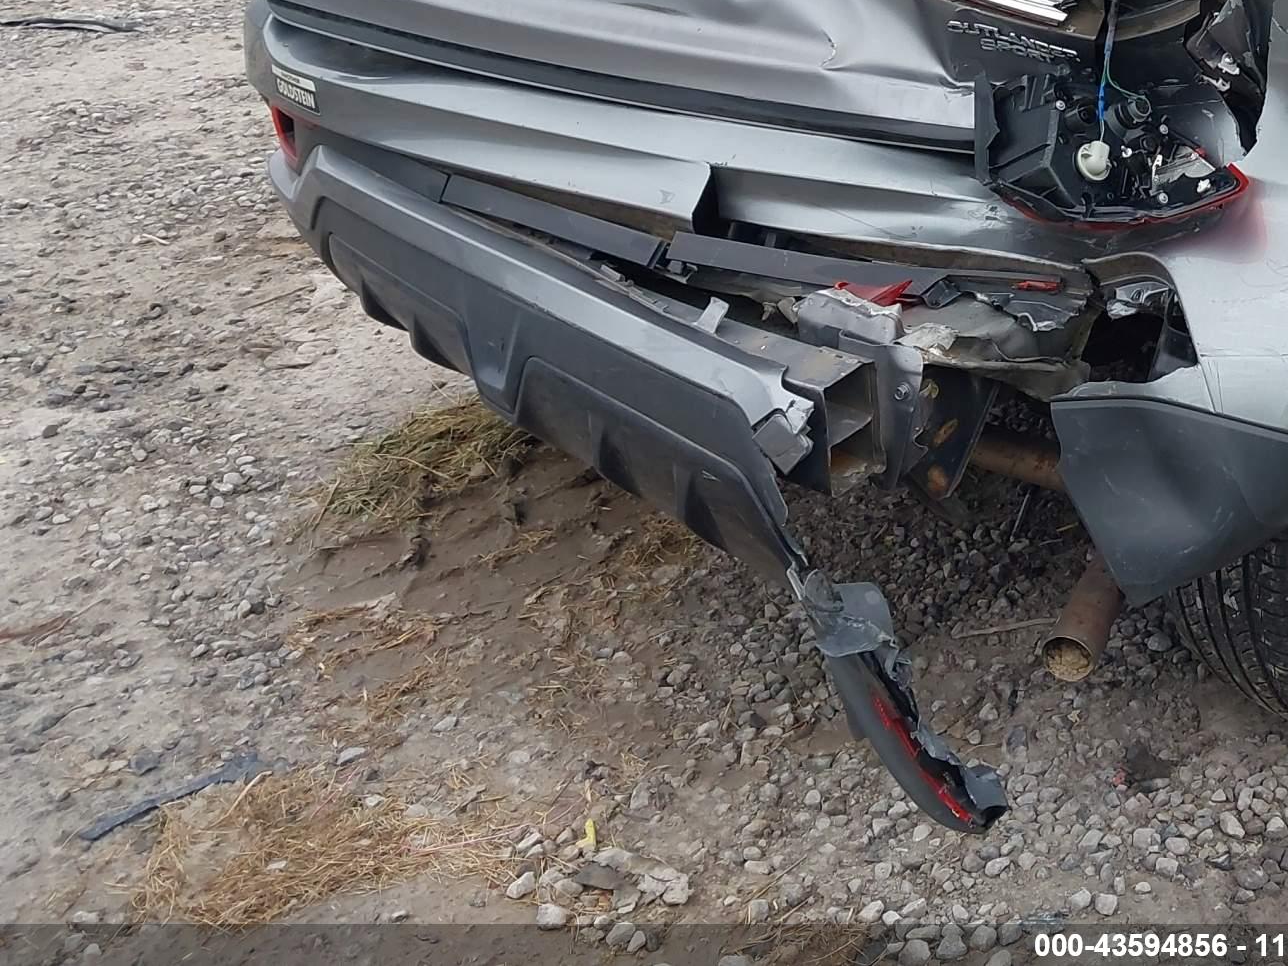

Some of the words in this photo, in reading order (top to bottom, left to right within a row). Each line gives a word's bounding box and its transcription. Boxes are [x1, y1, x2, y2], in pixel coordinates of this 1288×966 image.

[945, 20, 1081, 63] OUTLANDER
[979, 37, 1056, 64] SPORT
[276, 77, 316, 109] GOLDSTEIN
